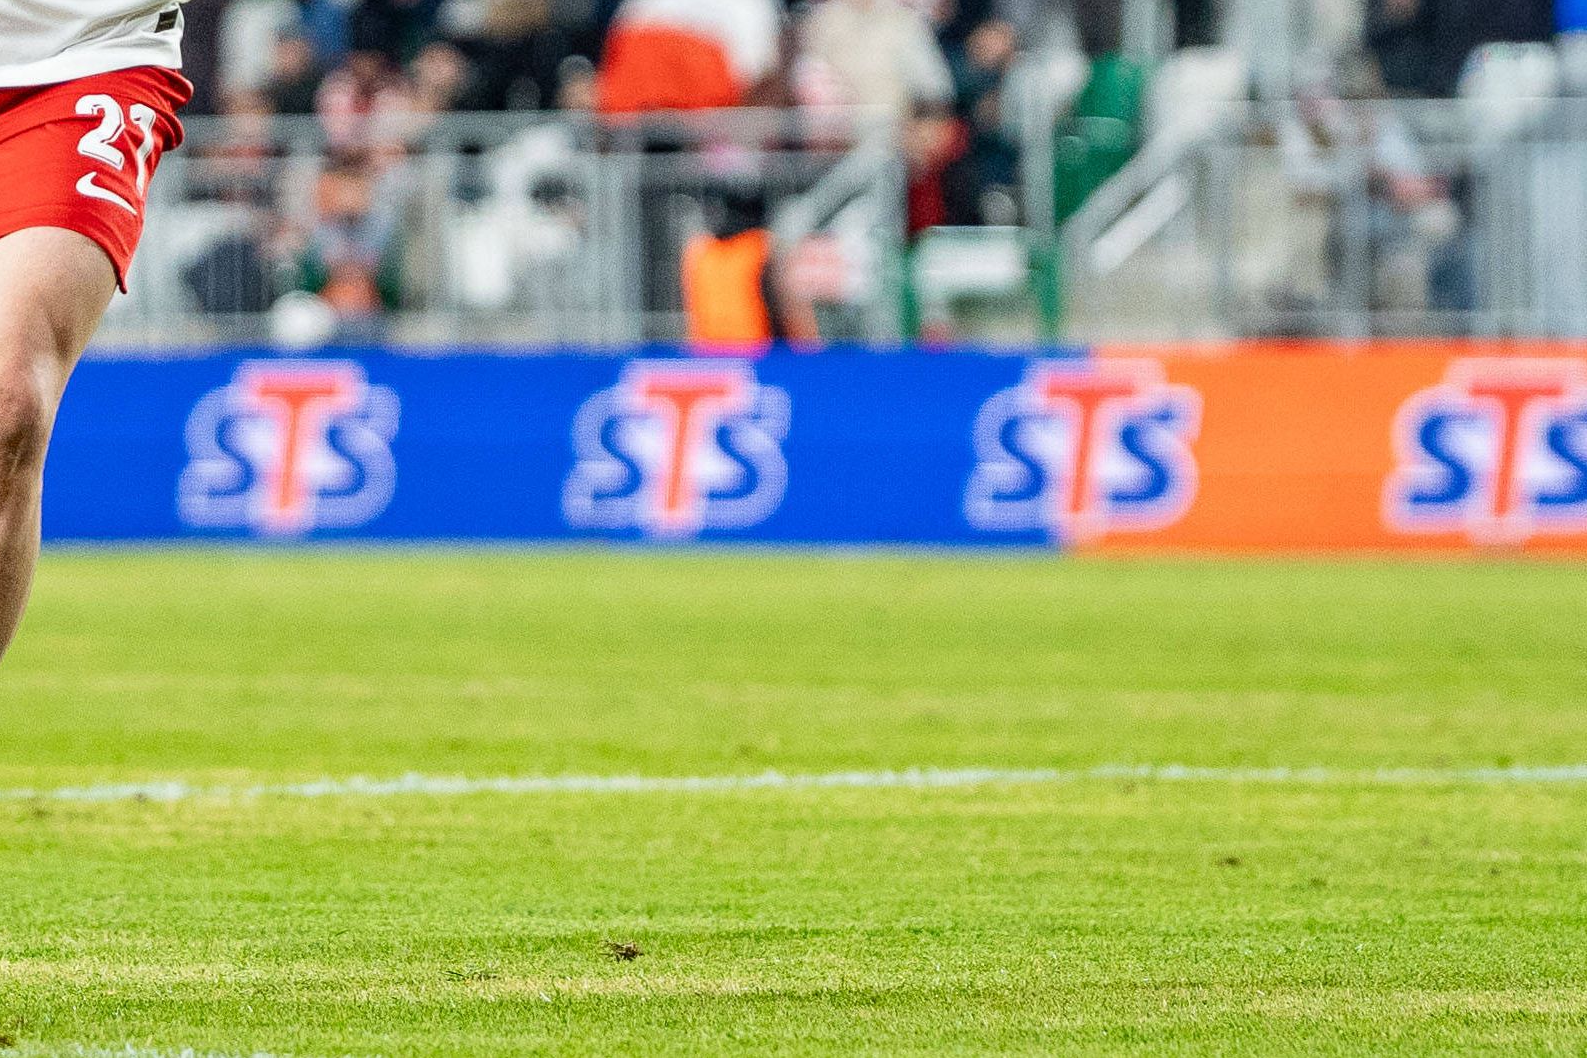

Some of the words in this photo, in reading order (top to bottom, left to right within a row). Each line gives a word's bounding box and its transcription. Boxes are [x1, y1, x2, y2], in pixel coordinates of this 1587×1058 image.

[75, 92, 156, 198] 21
[177, 359, 400, 533] STS
[562, 358, 791, 538] STS
[962, 358, 1204, 542] STS
